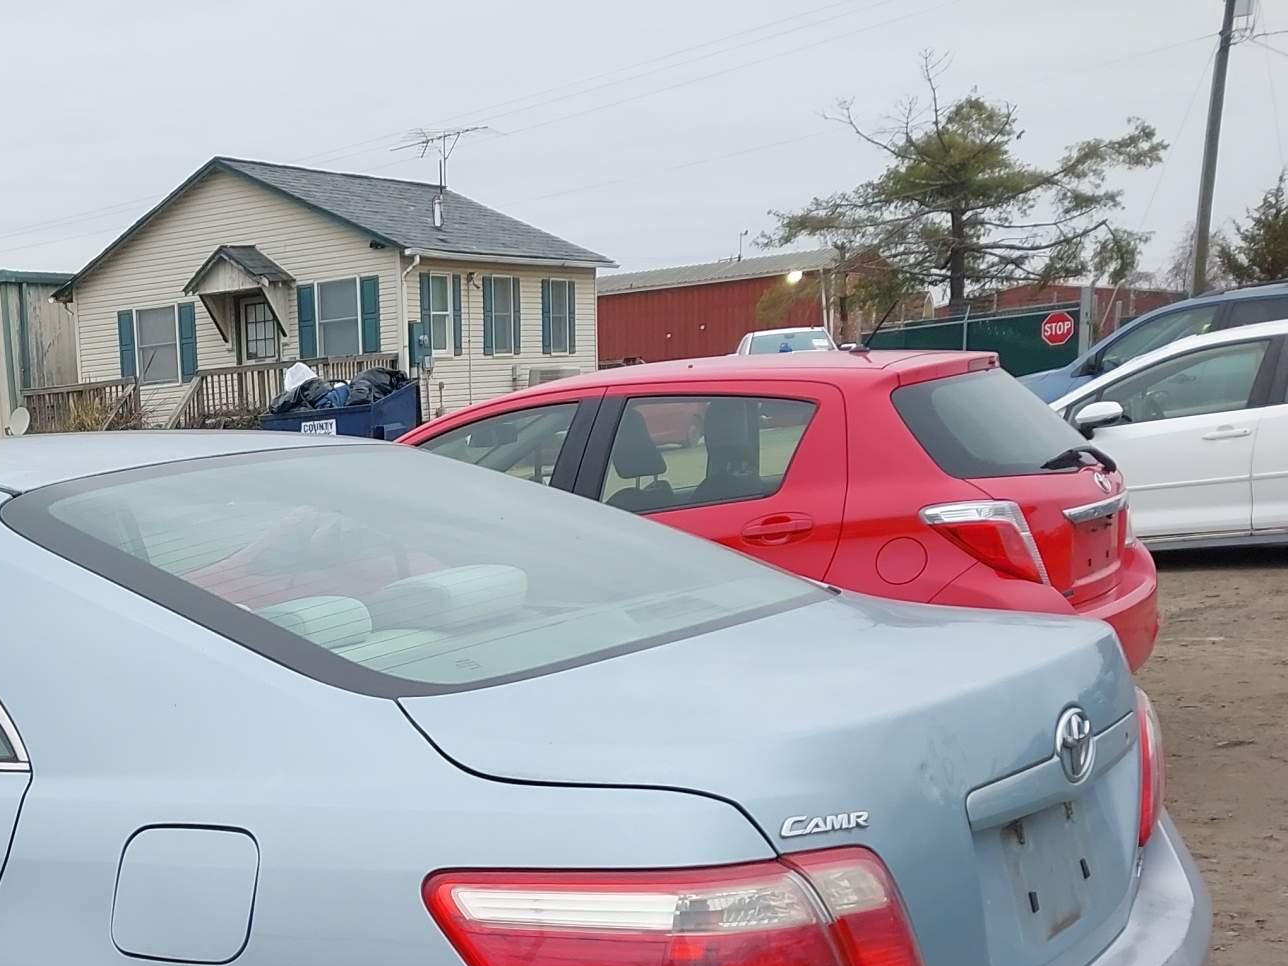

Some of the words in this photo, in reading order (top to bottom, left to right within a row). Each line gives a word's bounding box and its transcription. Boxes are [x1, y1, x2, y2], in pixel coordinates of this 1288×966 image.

[1044, 321, 1071, 335] STOP
[303, 421, 333, 432] COUNTY
[780, 811, 870, 837] CAMR
